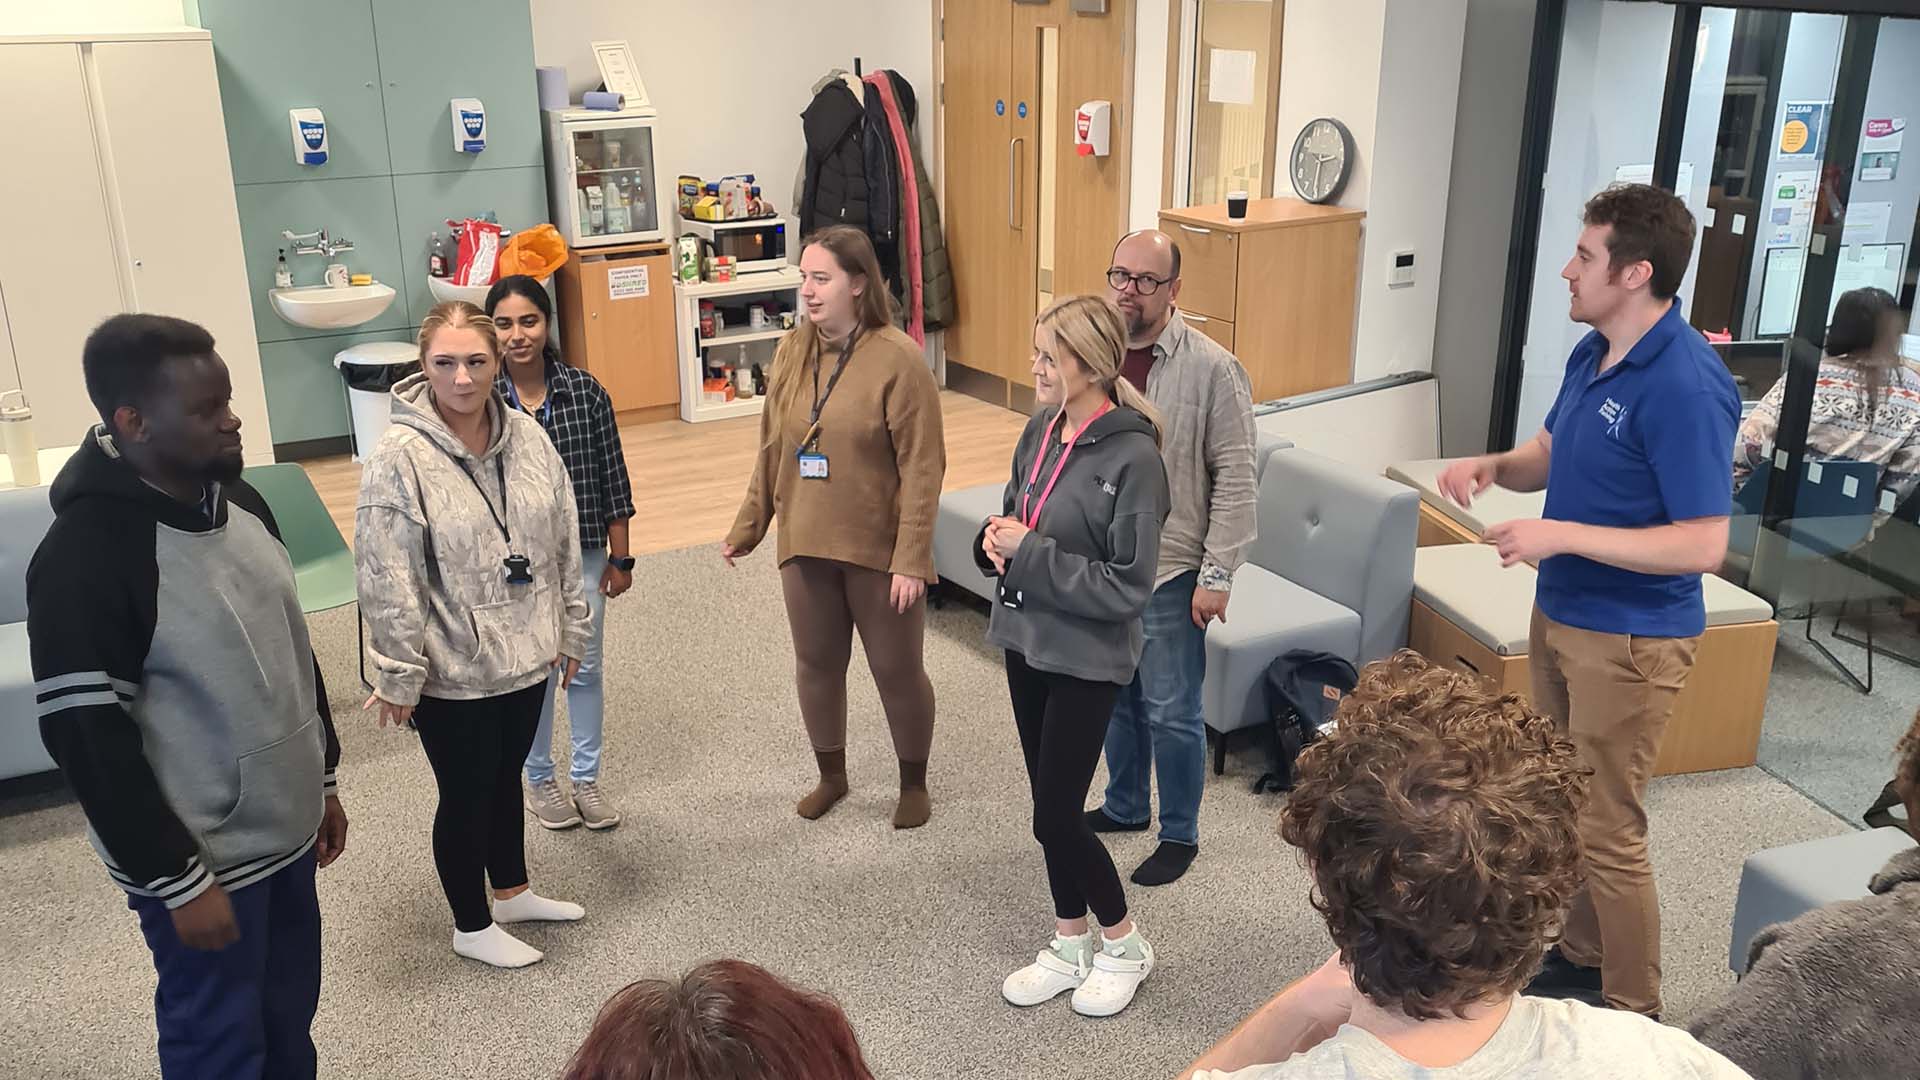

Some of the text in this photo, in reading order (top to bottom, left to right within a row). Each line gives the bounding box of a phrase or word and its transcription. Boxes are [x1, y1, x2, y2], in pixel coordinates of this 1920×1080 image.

[1788, 105, 1812, 113] CLEAR
[1299, 152, 1304, 162] 9
[1303, 180, 1310, 191] 7
